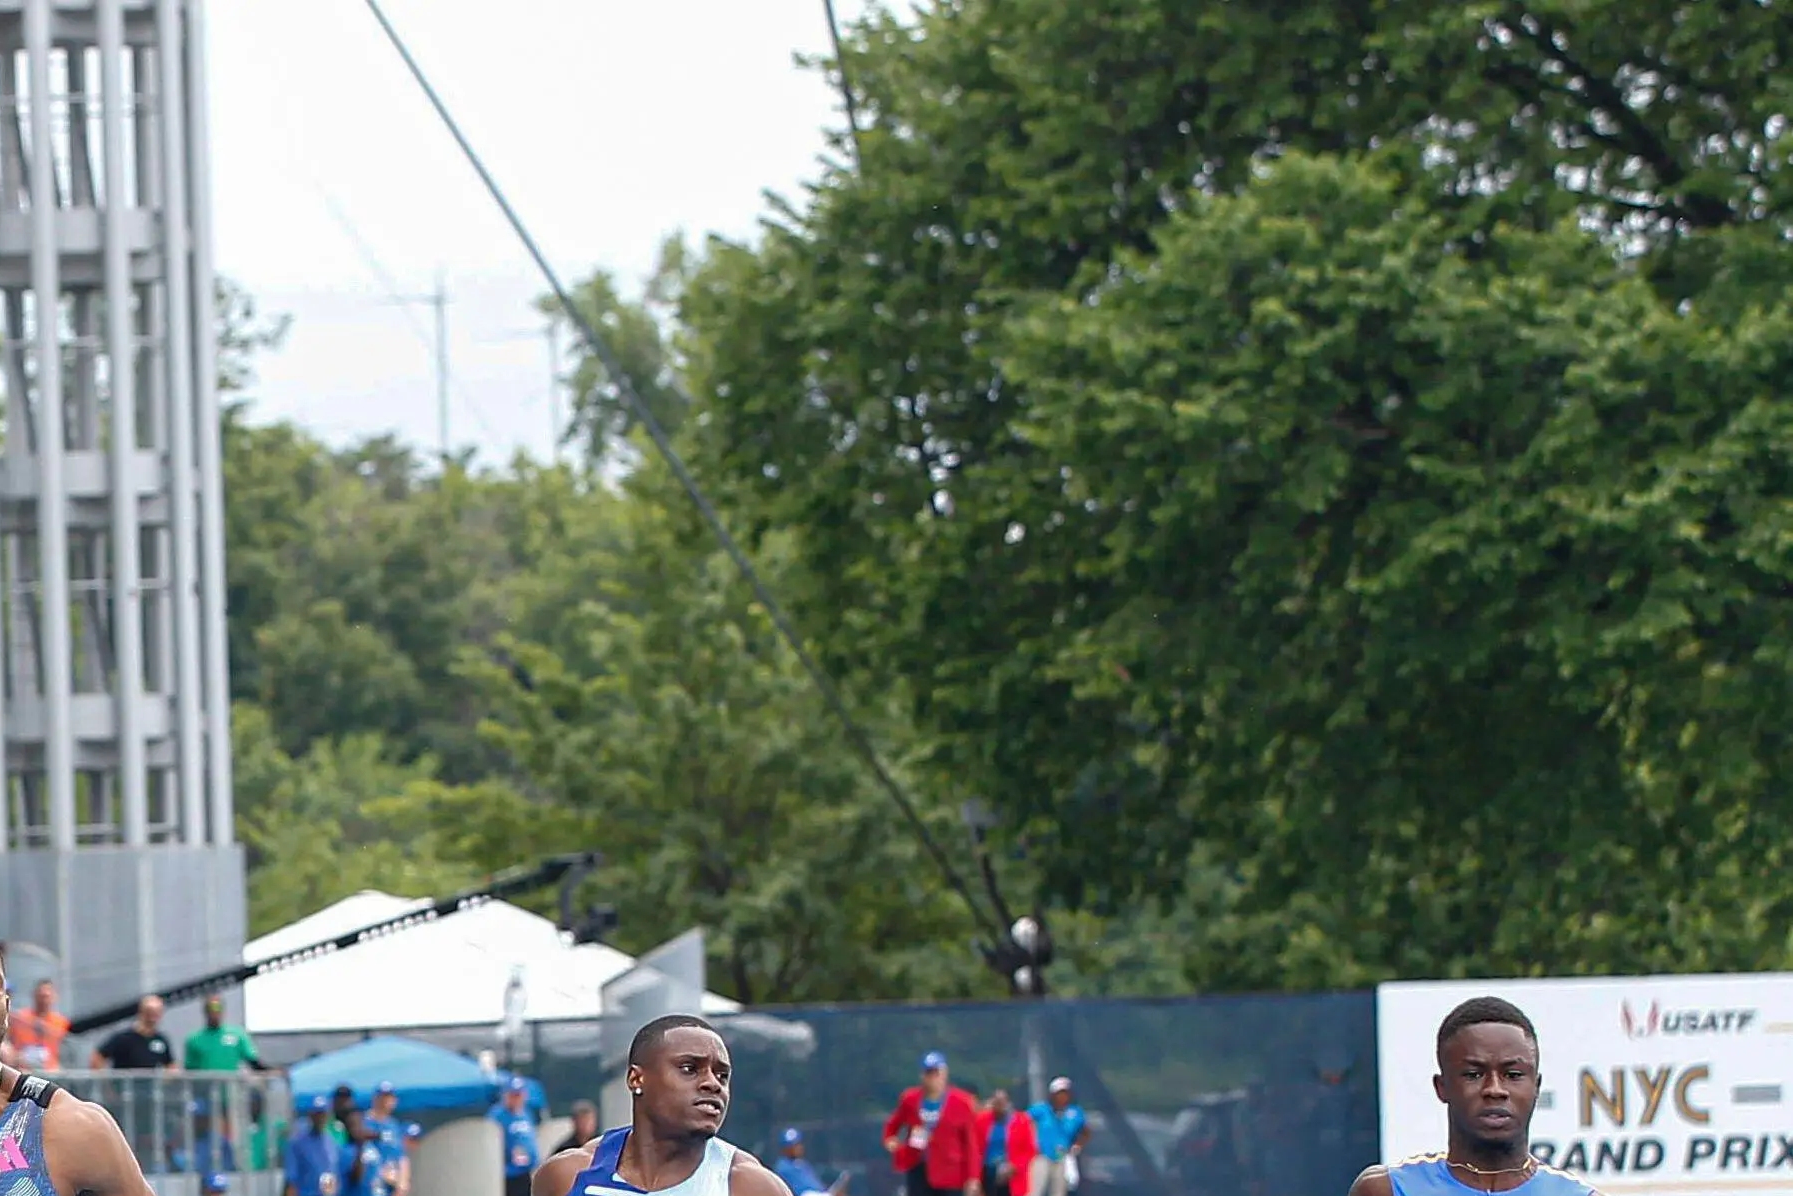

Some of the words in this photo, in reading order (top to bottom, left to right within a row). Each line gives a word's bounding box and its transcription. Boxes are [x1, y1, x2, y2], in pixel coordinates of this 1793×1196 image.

[1662, 1010, 1756, 1032] USATF
[1579, 1064, 1711, 1127] NYC
[1530, 1136, 1664, 1171] RAND
